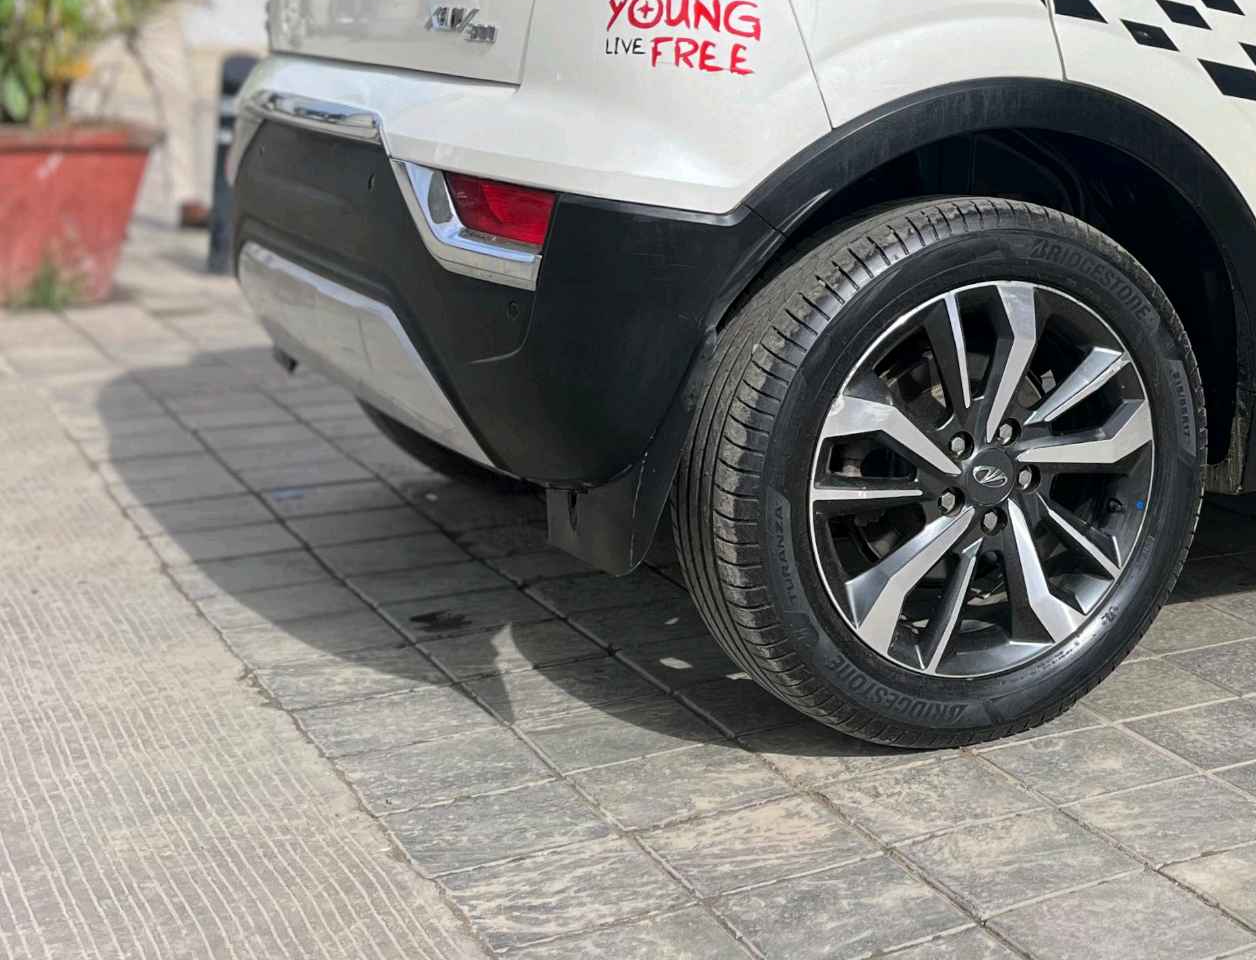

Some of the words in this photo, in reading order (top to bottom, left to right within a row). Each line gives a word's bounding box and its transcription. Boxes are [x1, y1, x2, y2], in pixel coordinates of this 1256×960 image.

[605, 37, 646, 55] LIVE
[651, 37, 755, 75] FREE
[1030, 239, 1150, 318] BRIDGESTONE
[774, 502, 797, 602] TURANZA
[825, 656, 968, 725] BRIDGESTONE
